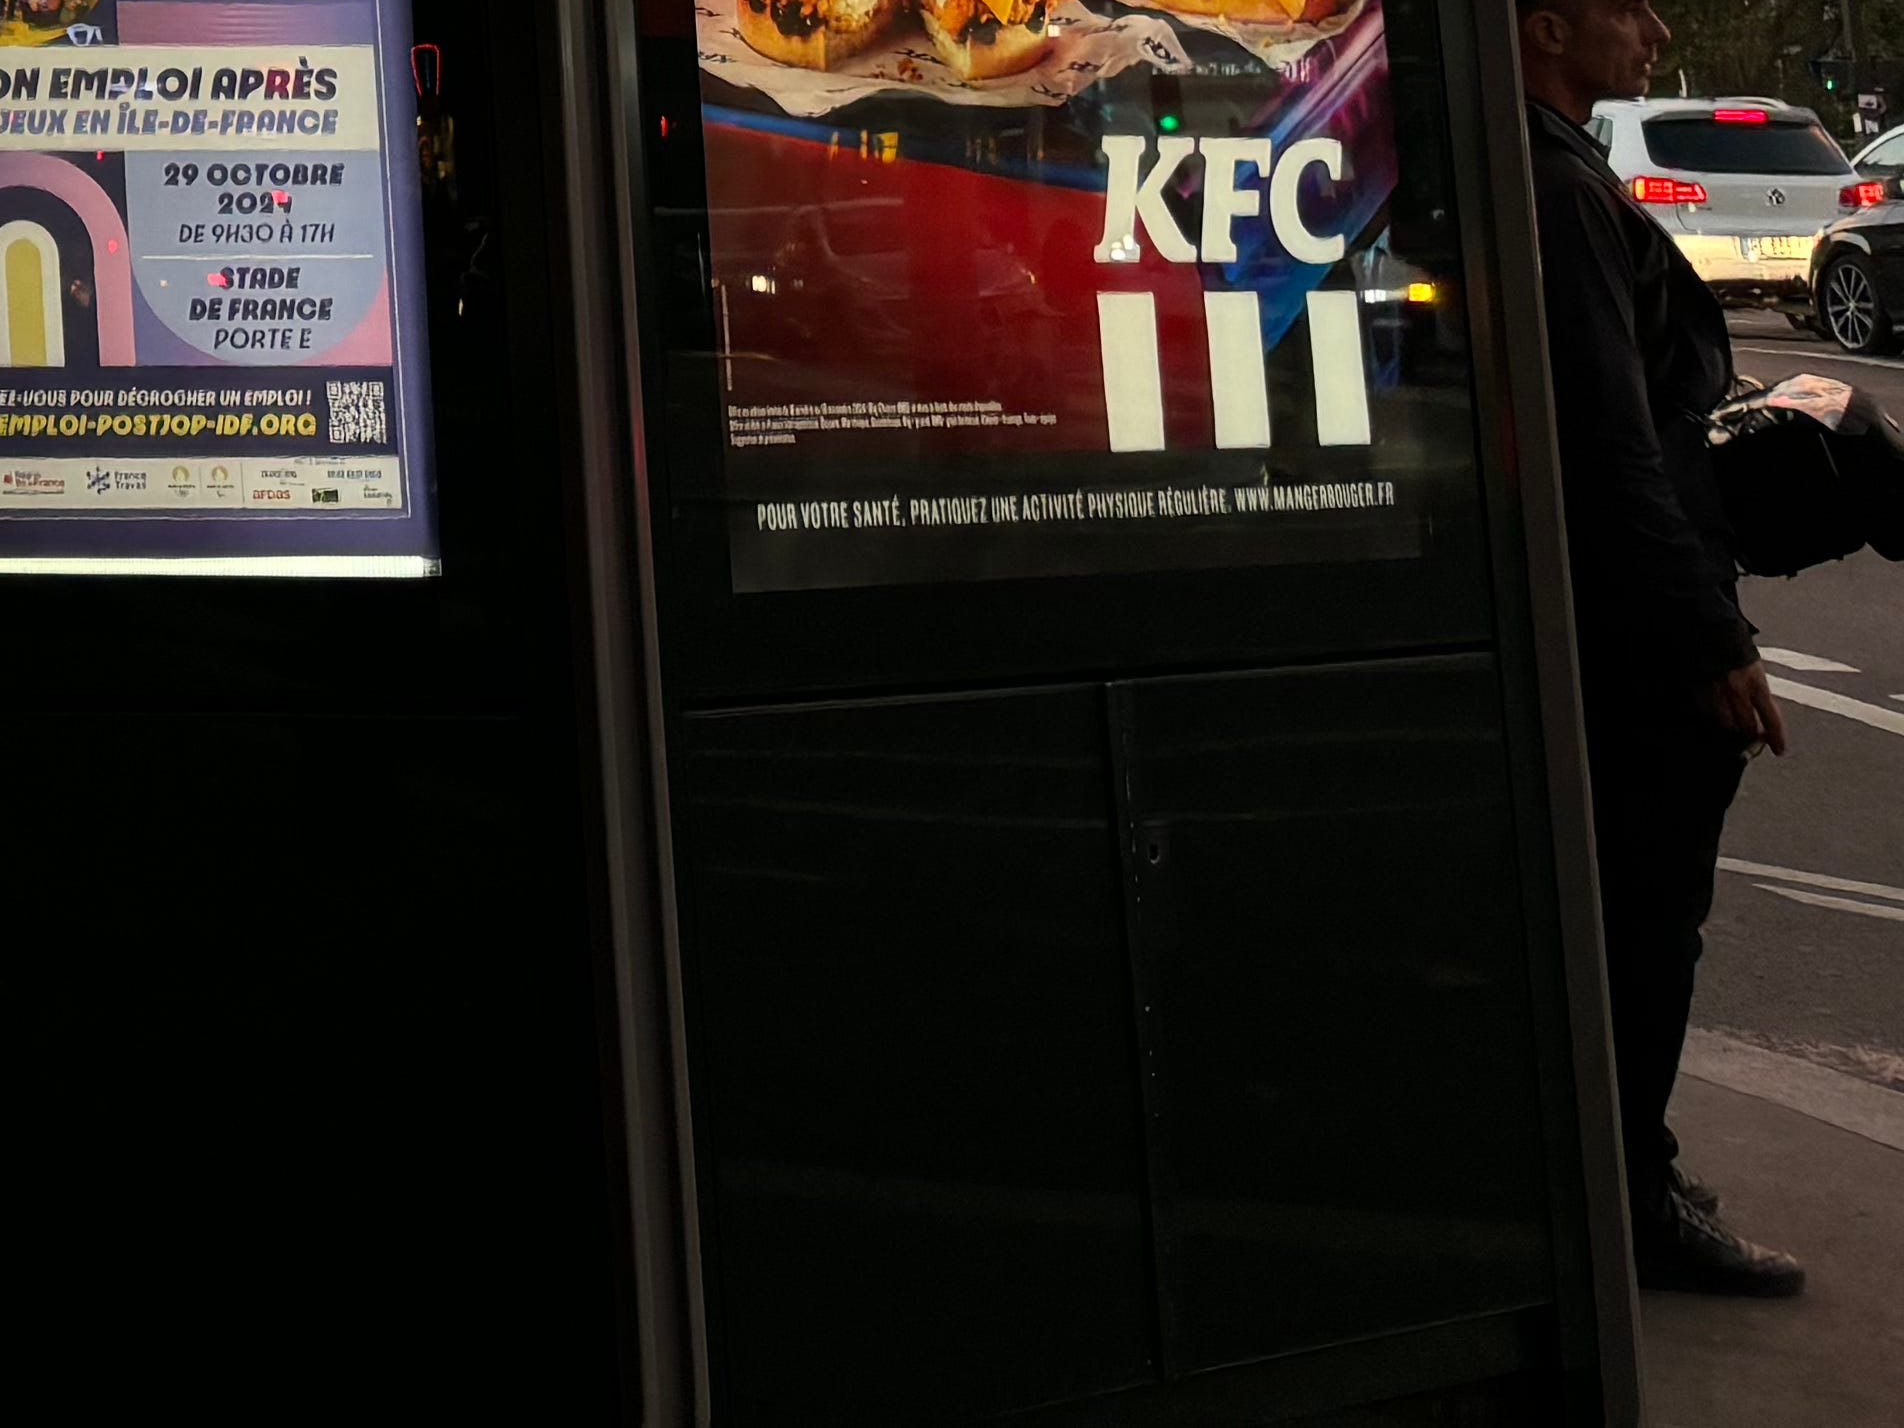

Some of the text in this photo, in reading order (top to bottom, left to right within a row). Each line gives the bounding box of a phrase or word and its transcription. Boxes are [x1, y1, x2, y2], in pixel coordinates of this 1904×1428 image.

[49, 66, 203, 100] EMPLOI
[211, 56, 338, 99] APRÈS
[75, 111, 111, 135] EN
[117, 102, 339, 136] ÎLE-DE-FRANCE
[164, 163, 344, 186] 29 OCTOBRE
[1093, 135, 1344, 264] KFC
[179, 218, 335, 244] DE 9H30 À 17H
[219, 267, 300, 290] STADE
[189, 298, 332, 321] DE FRANCE
[214, 328, 312, 350] PORTE E
[71, 390, 114, 407] POUR
[219, 390, 240, 406] UN
[243, 390, 303, 406] EMPLOI
[757, 502, 797, 534] POUR
[802, 501, 848, 531] VOTRE
[853, 494, 906, 530] SANTÉ,
[911, 497, 987, 528] PRATIQUEZ
[992, 497, 1018, 524] UNE
[1023, 488, 1084, 523] ACTIVITÉ
[1088, 492, 1155, 522] PHYSIQUE
[1235, 480, 1395, 513] WWW.MANGERBOUGER.FR
